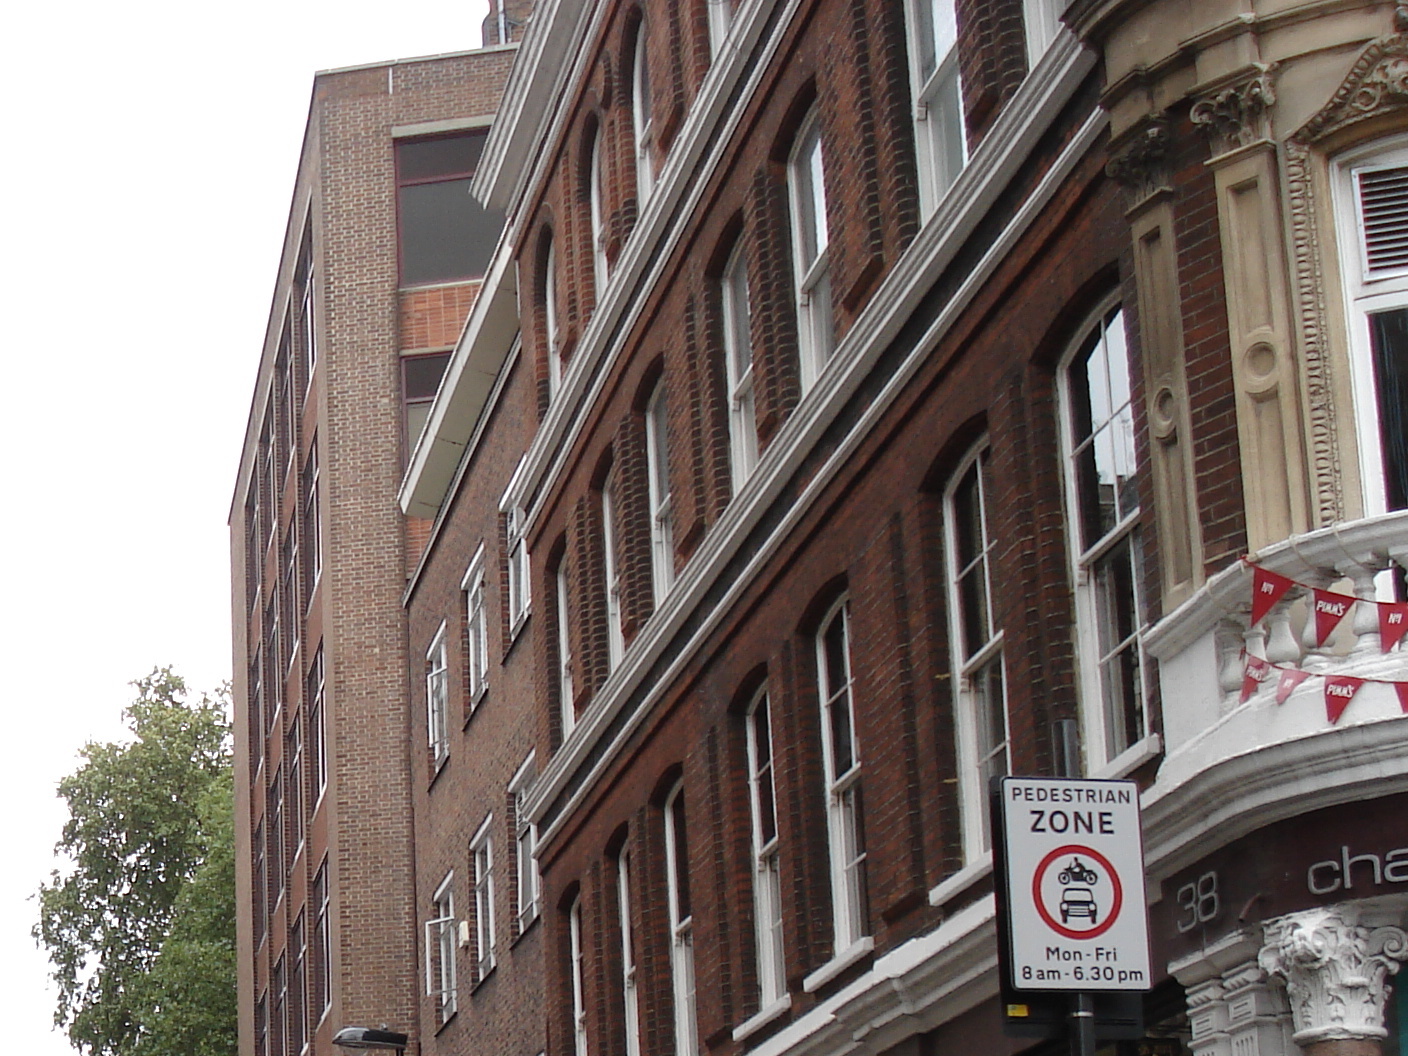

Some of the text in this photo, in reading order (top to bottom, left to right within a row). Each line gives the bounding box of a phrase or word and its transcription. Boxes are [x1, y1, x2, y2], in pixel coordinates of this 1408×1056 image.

[1317, 600, 1345, 616] PIMM'S
[1012, 787, 1130, 804] PEDESTRIAN
[1030, 810, 1115, 834] ZONE
[1177, 871, 1219, 933] 38
